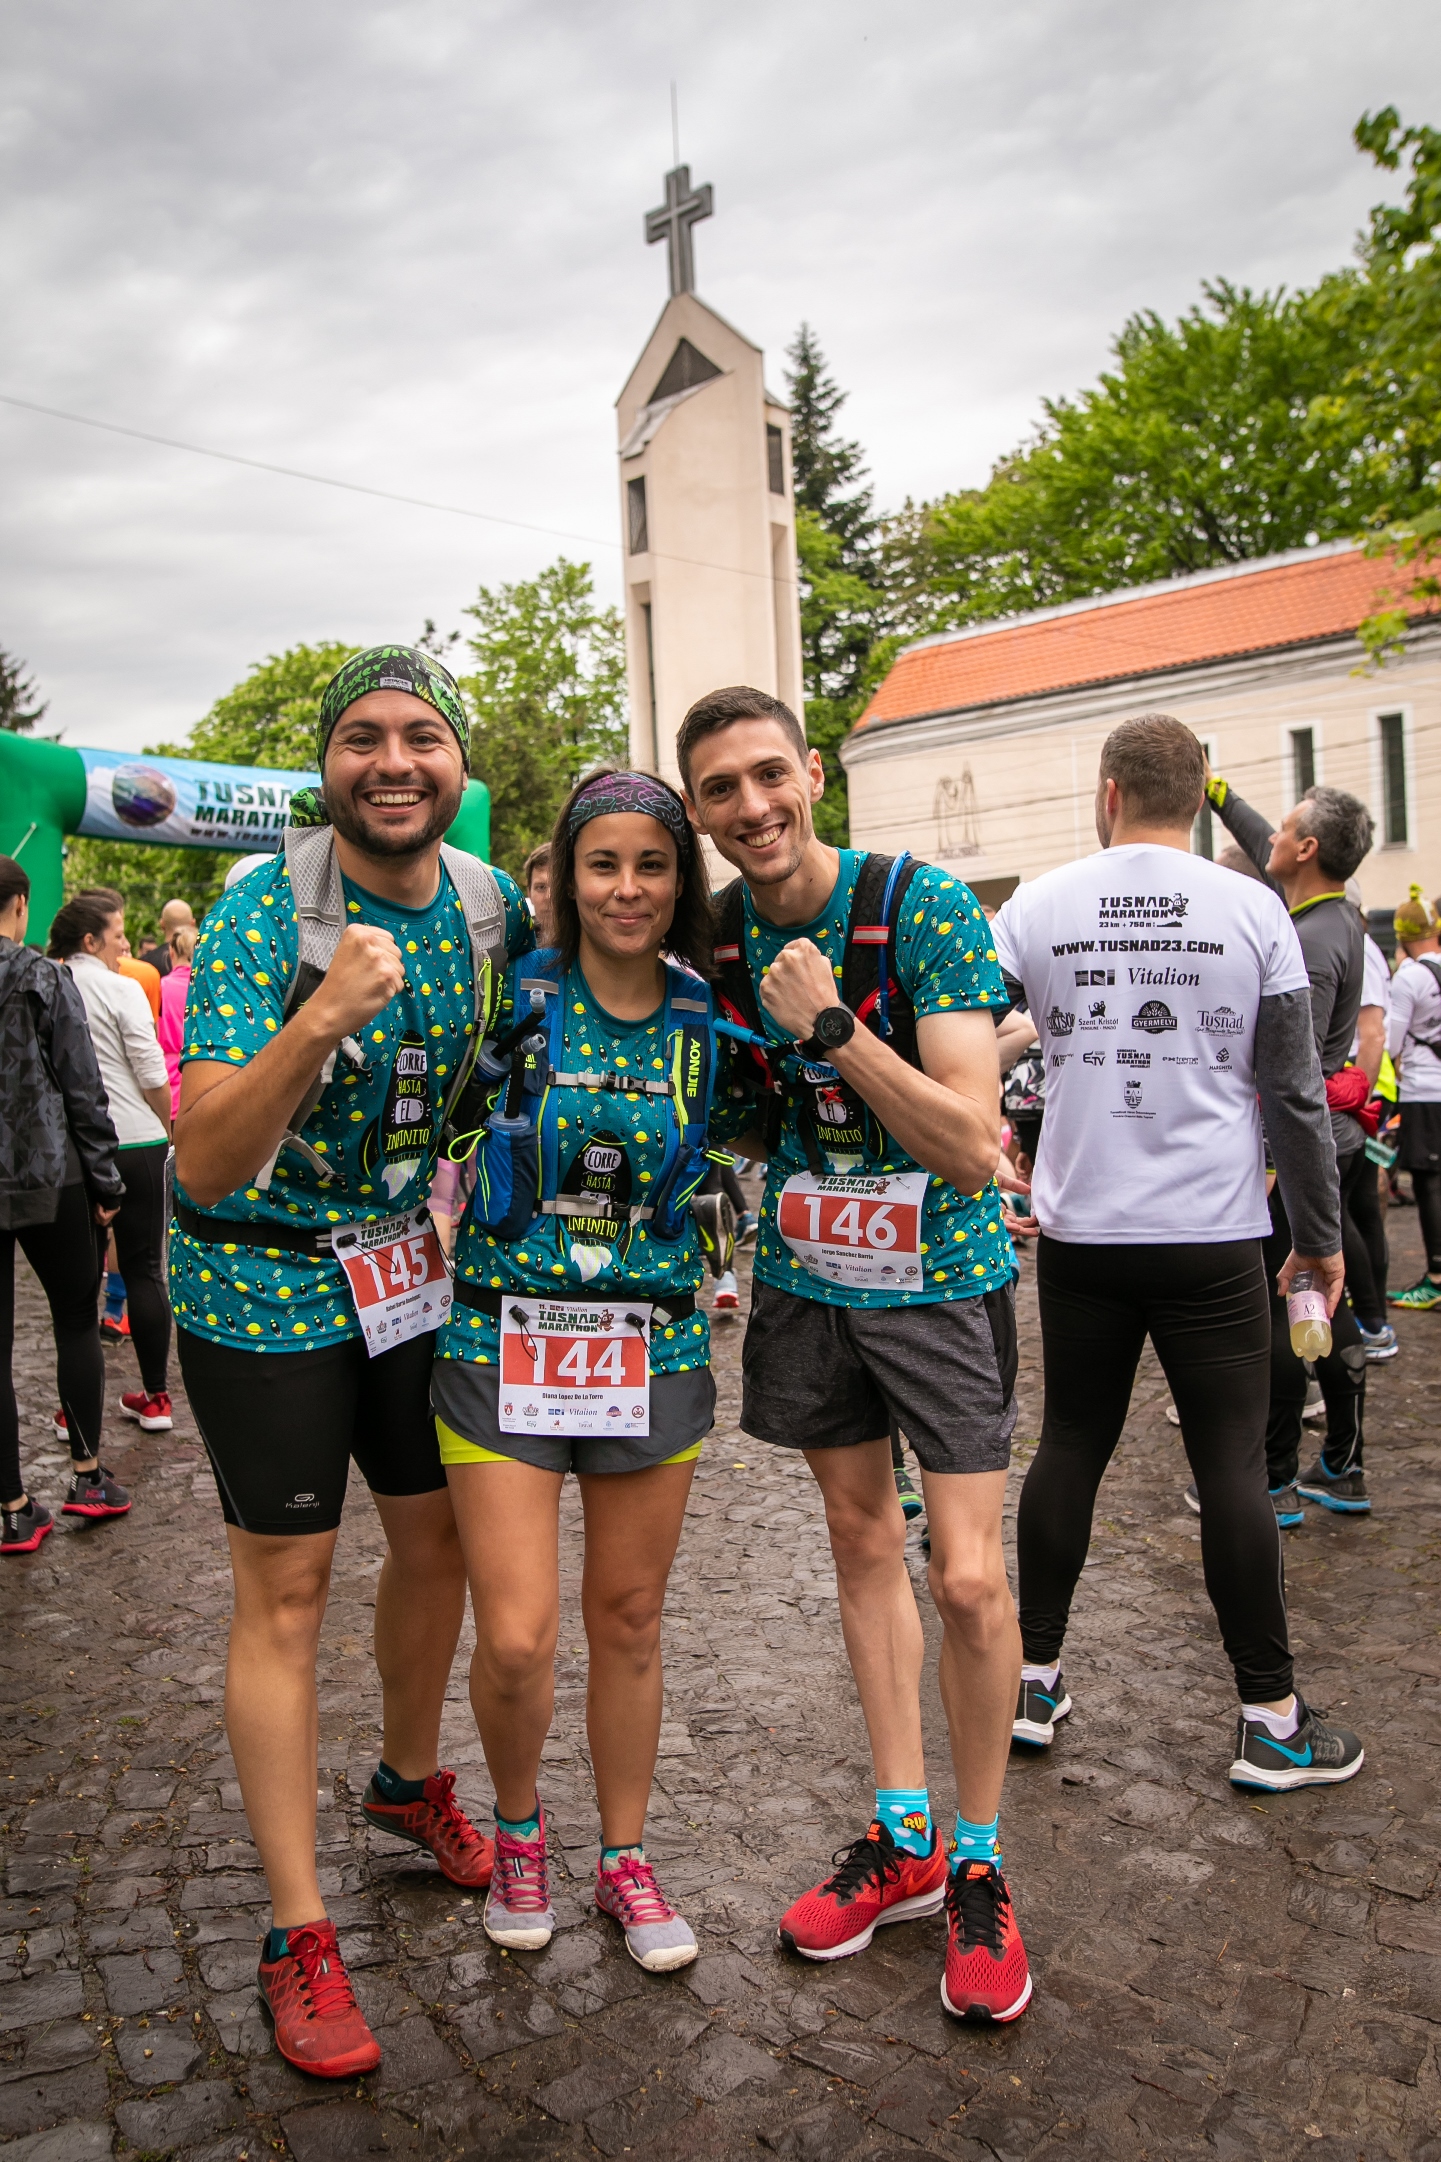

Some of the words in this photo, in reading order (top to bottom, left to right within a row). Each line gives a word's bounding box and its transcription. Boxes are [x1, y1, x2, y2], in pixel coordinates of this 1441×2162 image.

[195, 780, 293, 808] TUSNA
[195, 805, 295, 830] MARATH
[1099, 896, 1169, 908] TUSNAD
[1098, 909, 1169, 919] MARATHON
[1051, 939, 1224, 957] WWW.TUSNAD23.COM
[1128, 966, 1200, 987] Vitalion
[1078, 1018, 1096, 1026] Szent
[1133, 1018, 1176, 1028] GYERMELYI
[686, 1037, 701, 1098] AONIJIE
[398, 1079, 421, 1095] HASTA
[400, 1099, 412, 1122] EL
[826, 1103, 839, 1122] EL
[816, 1125, 863, 1143] INFINITO
[587, 1150, 619, 1169] CORRE
[586, 1174, 611, 1190] HASTA
[817, 1185, 871, 1195] MARATHON
[821, 1177, 875, 1188] TUSNAD
[361, 1220, 402, 1241] TUSNAD
[568, 1216, 618, 1238] INFINITO
[803, 1196, 898, 1249] 146
[361, 1231, 401, 1249] MARATHON
[362, 1237, 428, 1299] 145
[845, 1264, 872, 1273] Vitalion
[538, 1311, 599, 1324] TUSNAD
[538, 1321, 598, 1333] MARATHON
[528, 1338, 626, 1385] 144
[569, 1408, 598, 1416] Vitalion
[969, 1863, 990, 1876] NIKE
